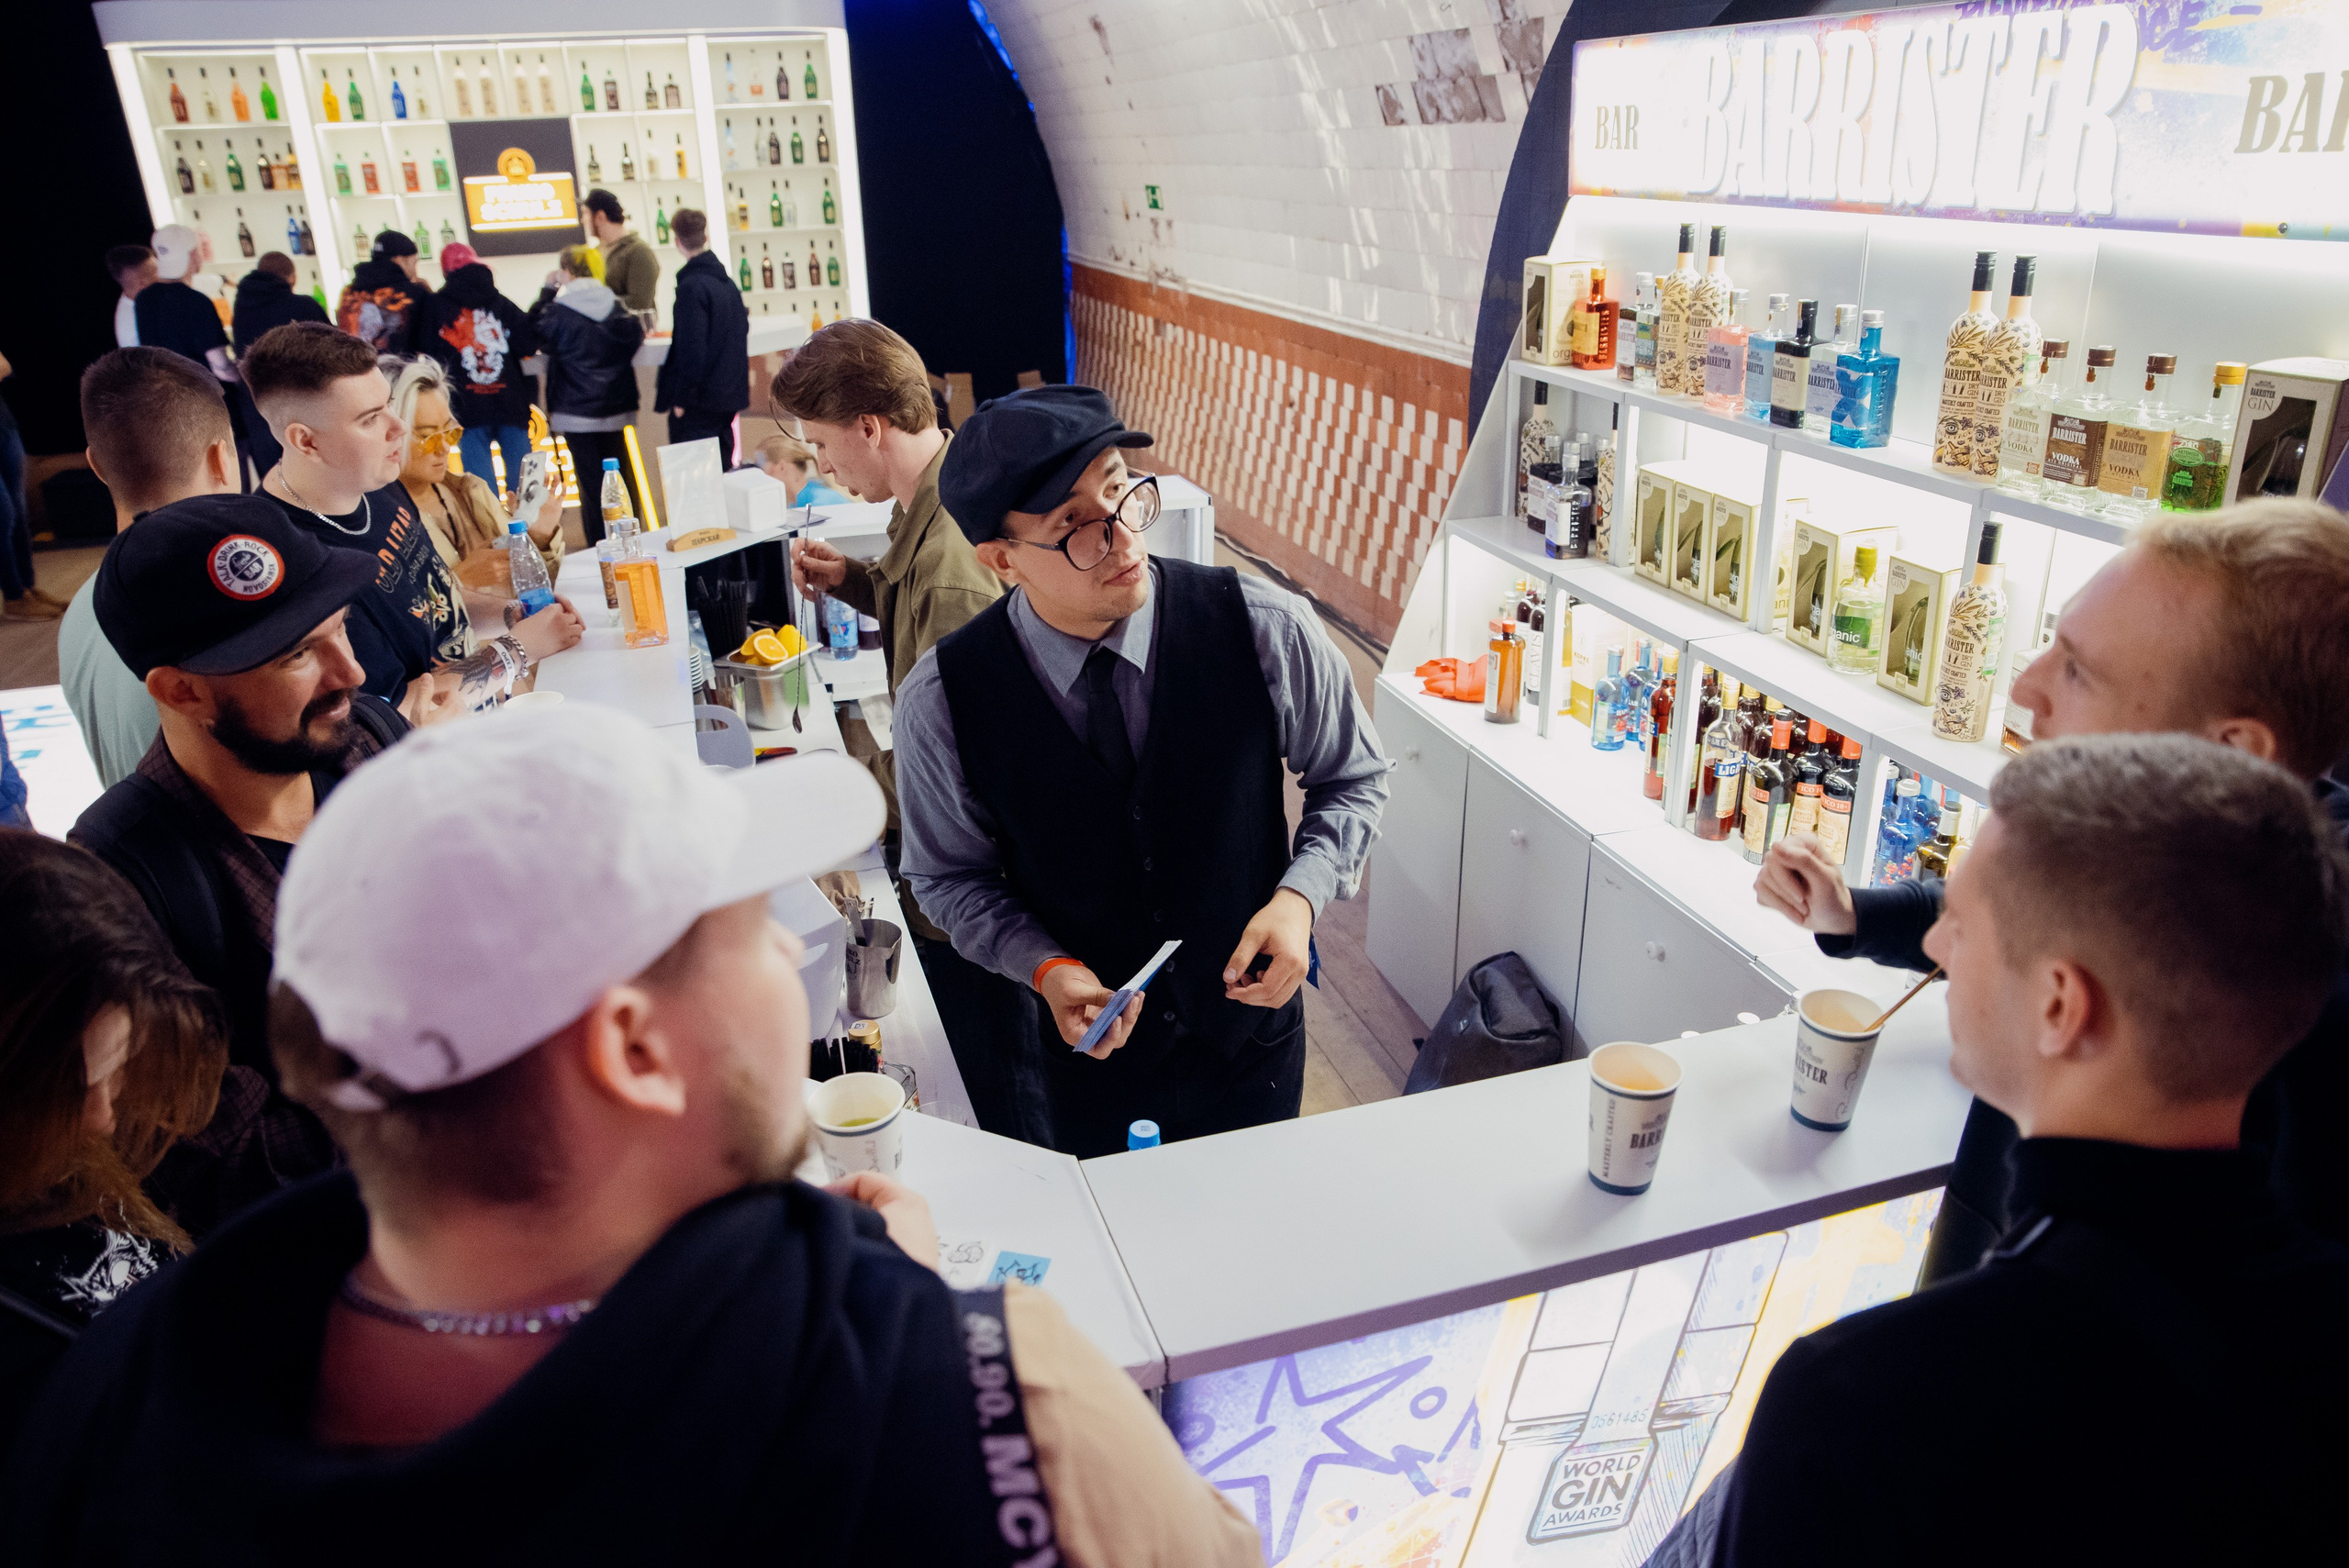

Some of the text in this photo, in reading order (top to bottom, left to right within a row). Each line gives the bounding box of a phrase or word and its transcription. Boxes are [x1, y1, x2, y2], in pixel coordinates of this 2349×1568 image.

[1687, 2, 2139, 217] BARRISTER
[1595, 105, 1640, 150] BAR
[2250, 387, 2276, 399] BARRISTER
[2247, 397, 2275, 412] GIN
[2008, 417, 2040, 433] BARRISTER
[2053, 427, 2087, 445] BARRISTER
[2008, 440, 2033, 454] VODKA
[2110, 438, 2148, 456] BARRISTER
[2052, 451, 2080, 465] VODKA
[2109, 463, 2141, 478] VODKA
[244, 541, 270, 557] ROCK
[243, 561, 263, 579] BAR
[1890, 576, 1906, 590] GIN
[1530, 634, 1542, 688] CLAVIS
[1564, 1454, 1641, 1479] WORLD
[1552, 1472, 1633, 1509] GIN
[1542, 1502, 1622, 1528] AWARDS
